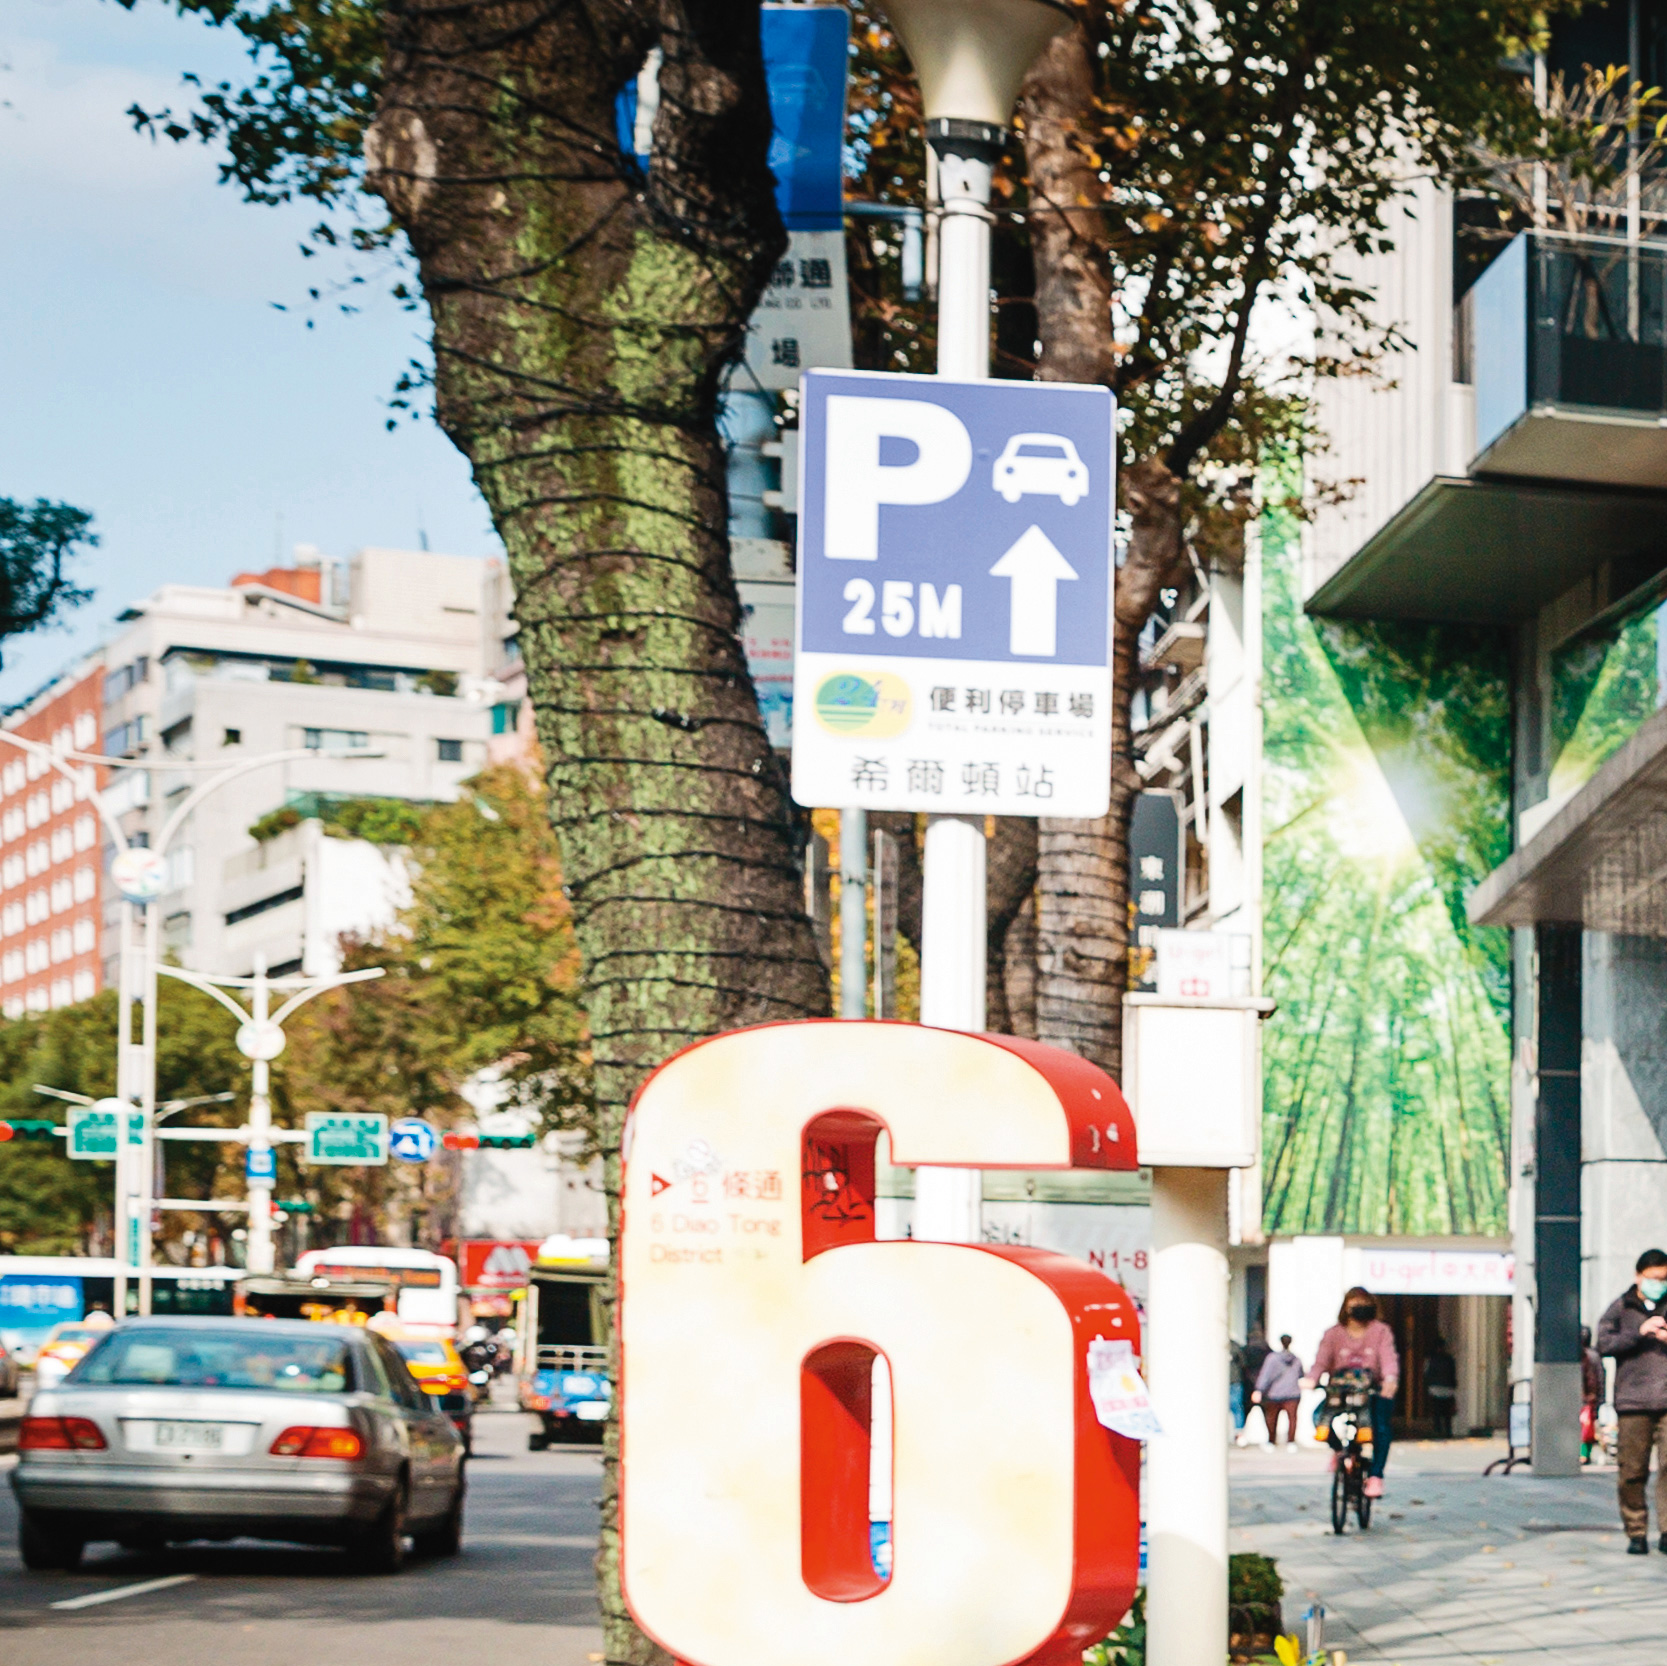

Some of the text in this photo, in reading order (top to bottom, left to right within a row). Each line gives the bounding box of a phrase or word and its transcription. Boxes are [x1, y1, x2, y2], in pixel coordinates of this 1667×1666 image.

[823, 394, 973, 562] P
[842, 577, 963, 639] 25M
[930, 686, 1095, 718] 便利停車場
[852, 755, 1055, 799] 希爾頓站
[728, 1212, 782, 1237] Tong
